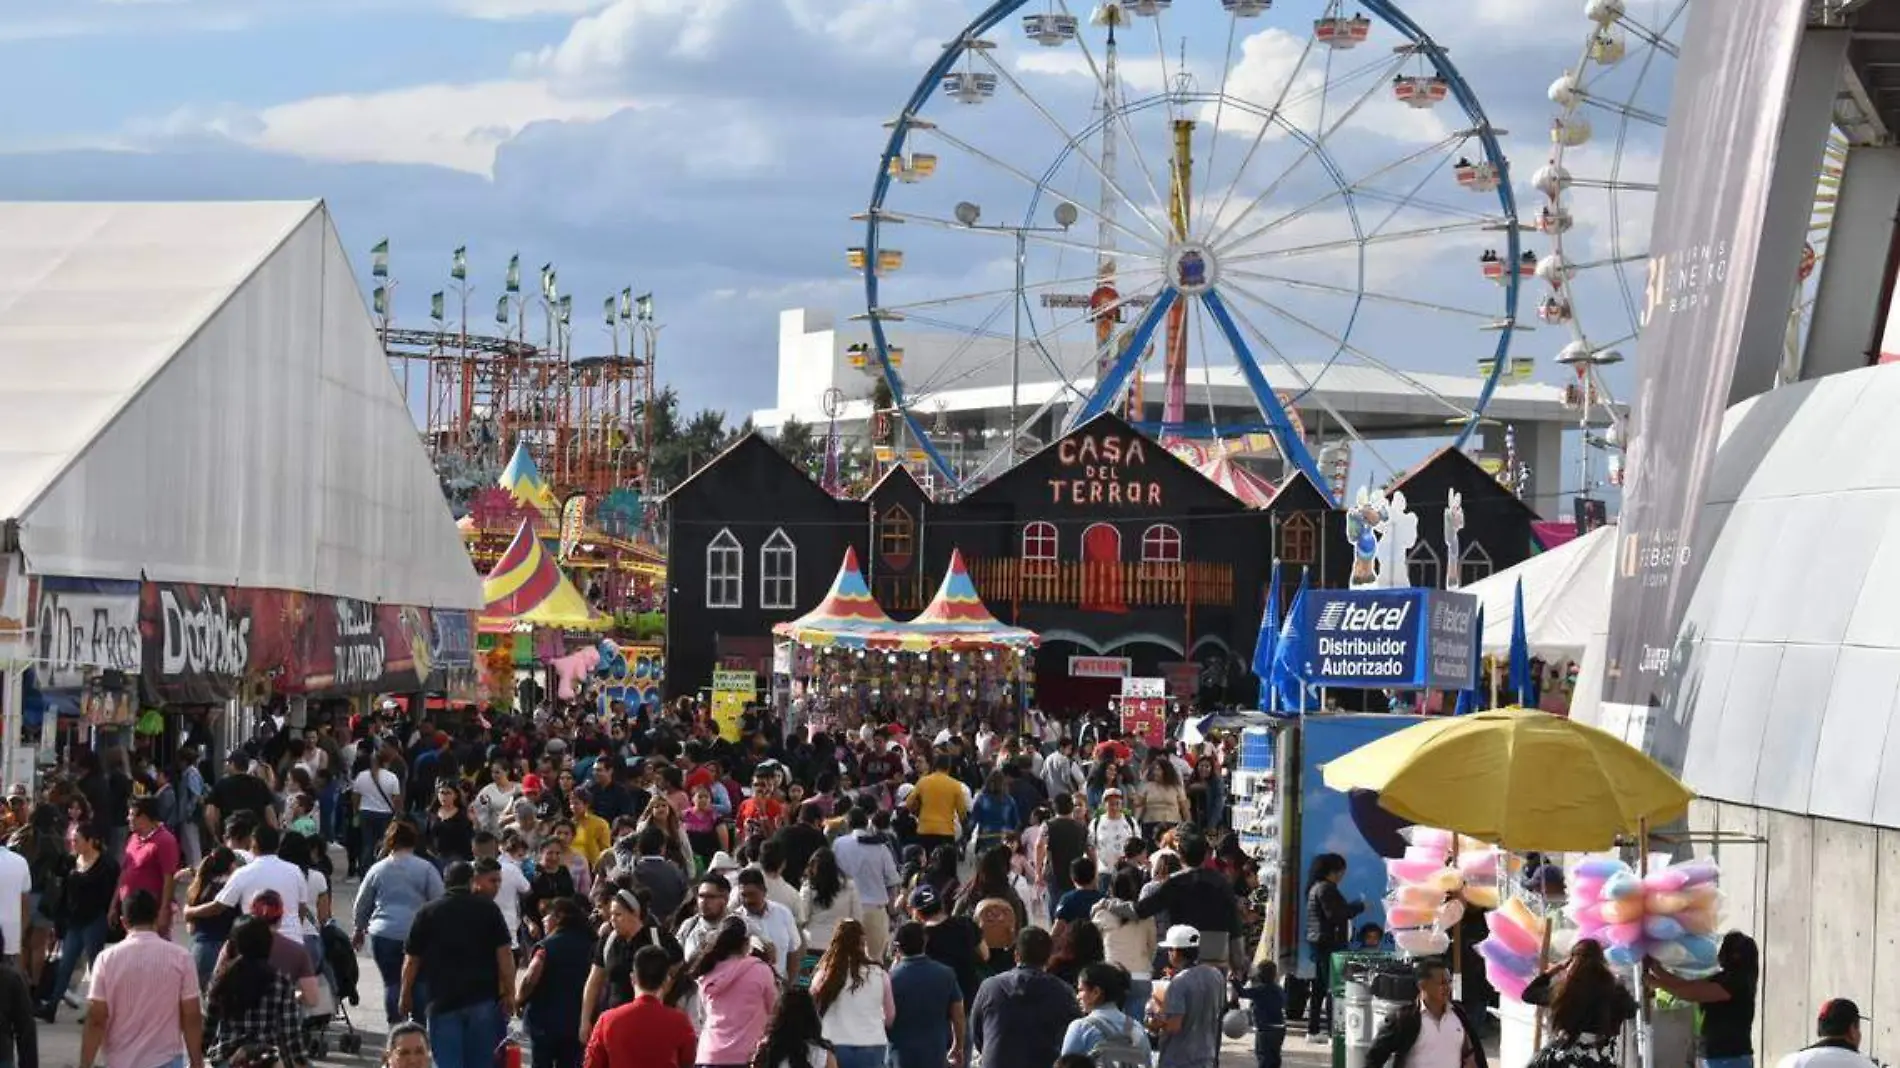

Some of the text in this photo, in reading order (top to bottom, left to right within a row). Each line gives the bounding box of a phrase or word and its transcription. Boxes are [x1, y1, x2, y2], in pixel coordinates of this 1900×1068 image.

[1058, 436, 1145, 466] CASA
[1086, 465, 1119, 479] DEL
[1048, 479, 1162, 507] TERROR
[1340, 601, 1411, 631] telcel
[1319, 637, 1407, 656] Distribuidor
[1321, 657, 1403, 676] Autorizado
